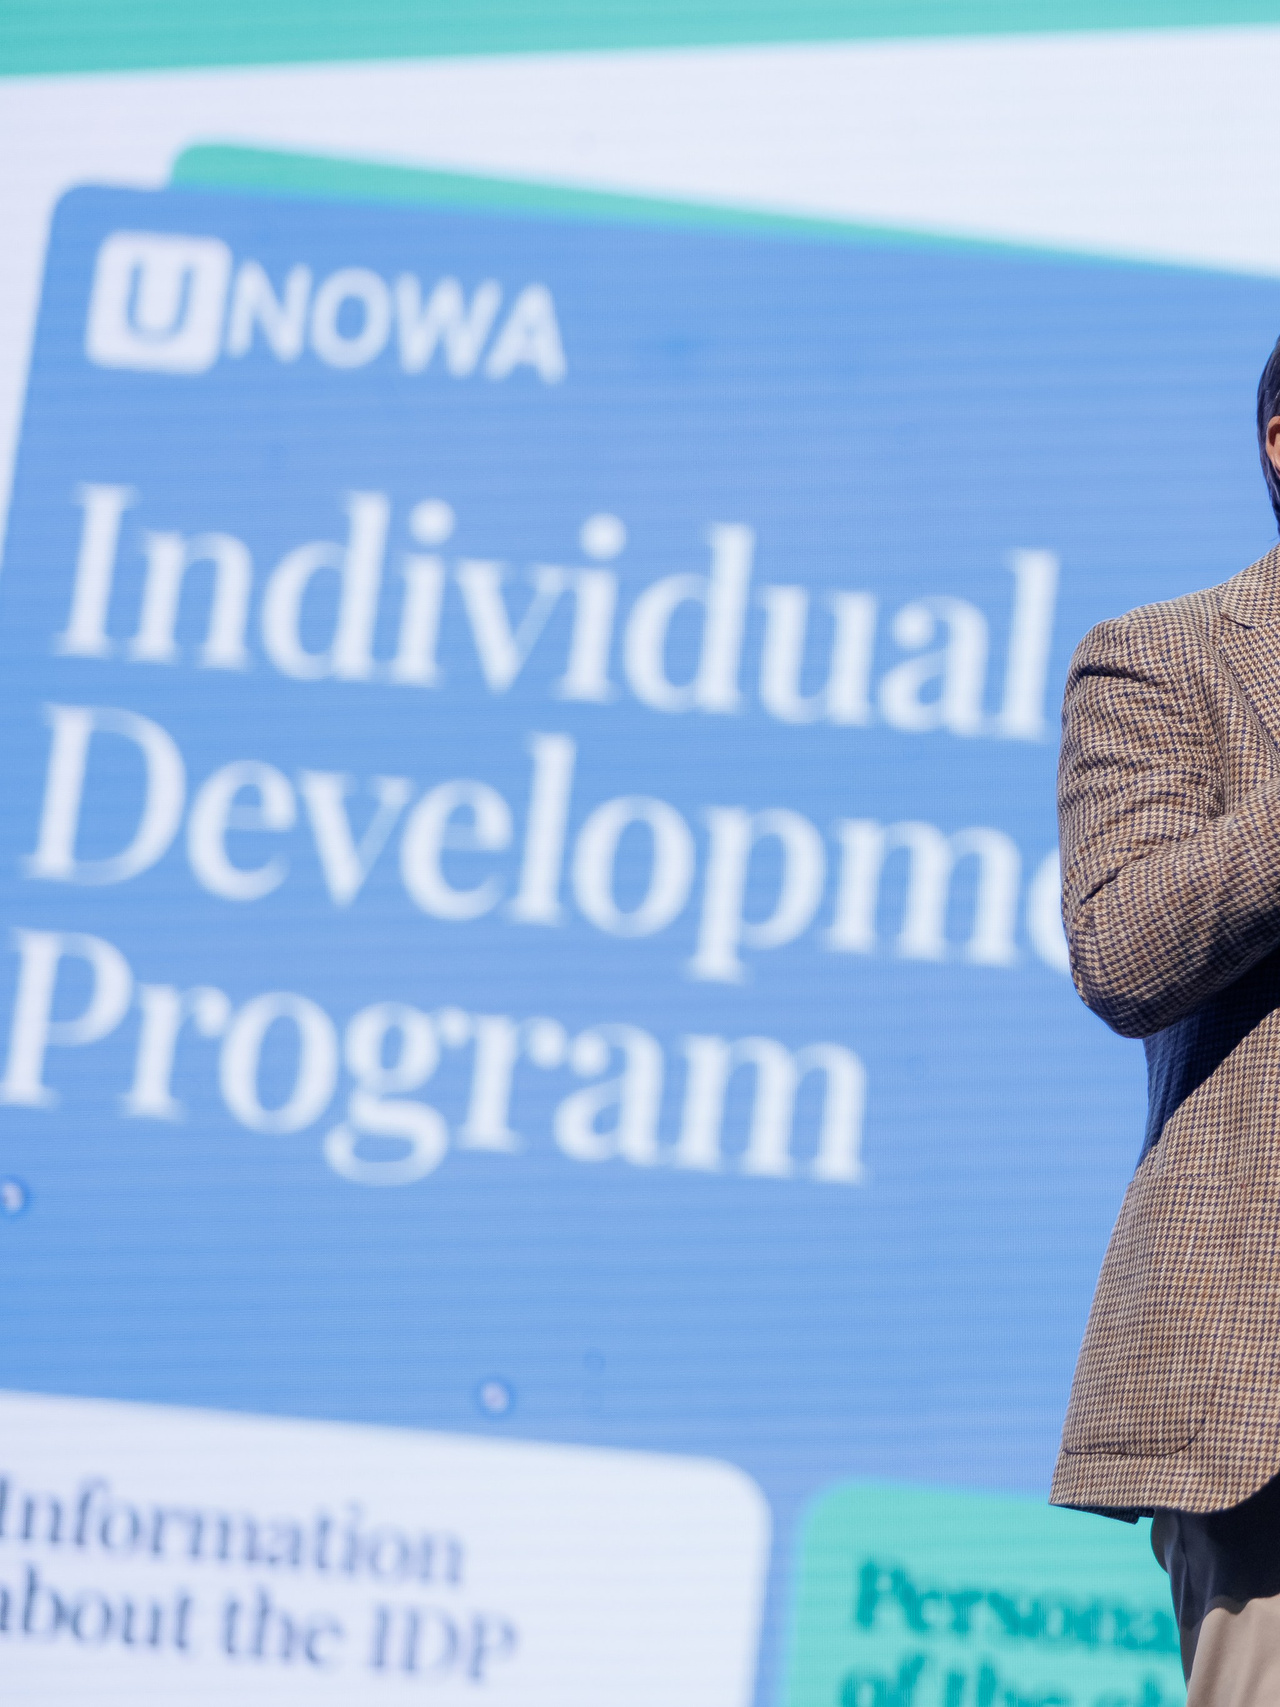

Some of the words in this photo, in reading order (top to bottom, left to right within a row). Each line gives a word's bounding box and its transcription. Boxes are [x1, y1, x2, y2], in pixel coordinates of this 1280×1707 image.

[88, 232, 567, 386] UNOWA
[52, 481, 1061, 743] Individual
[0, 928, 868, 1187] Program
[0, 1562, 194, 1654] bout
[219, 1586, 345, 1668] the
[367, 1600, 519, 1685] IDP
